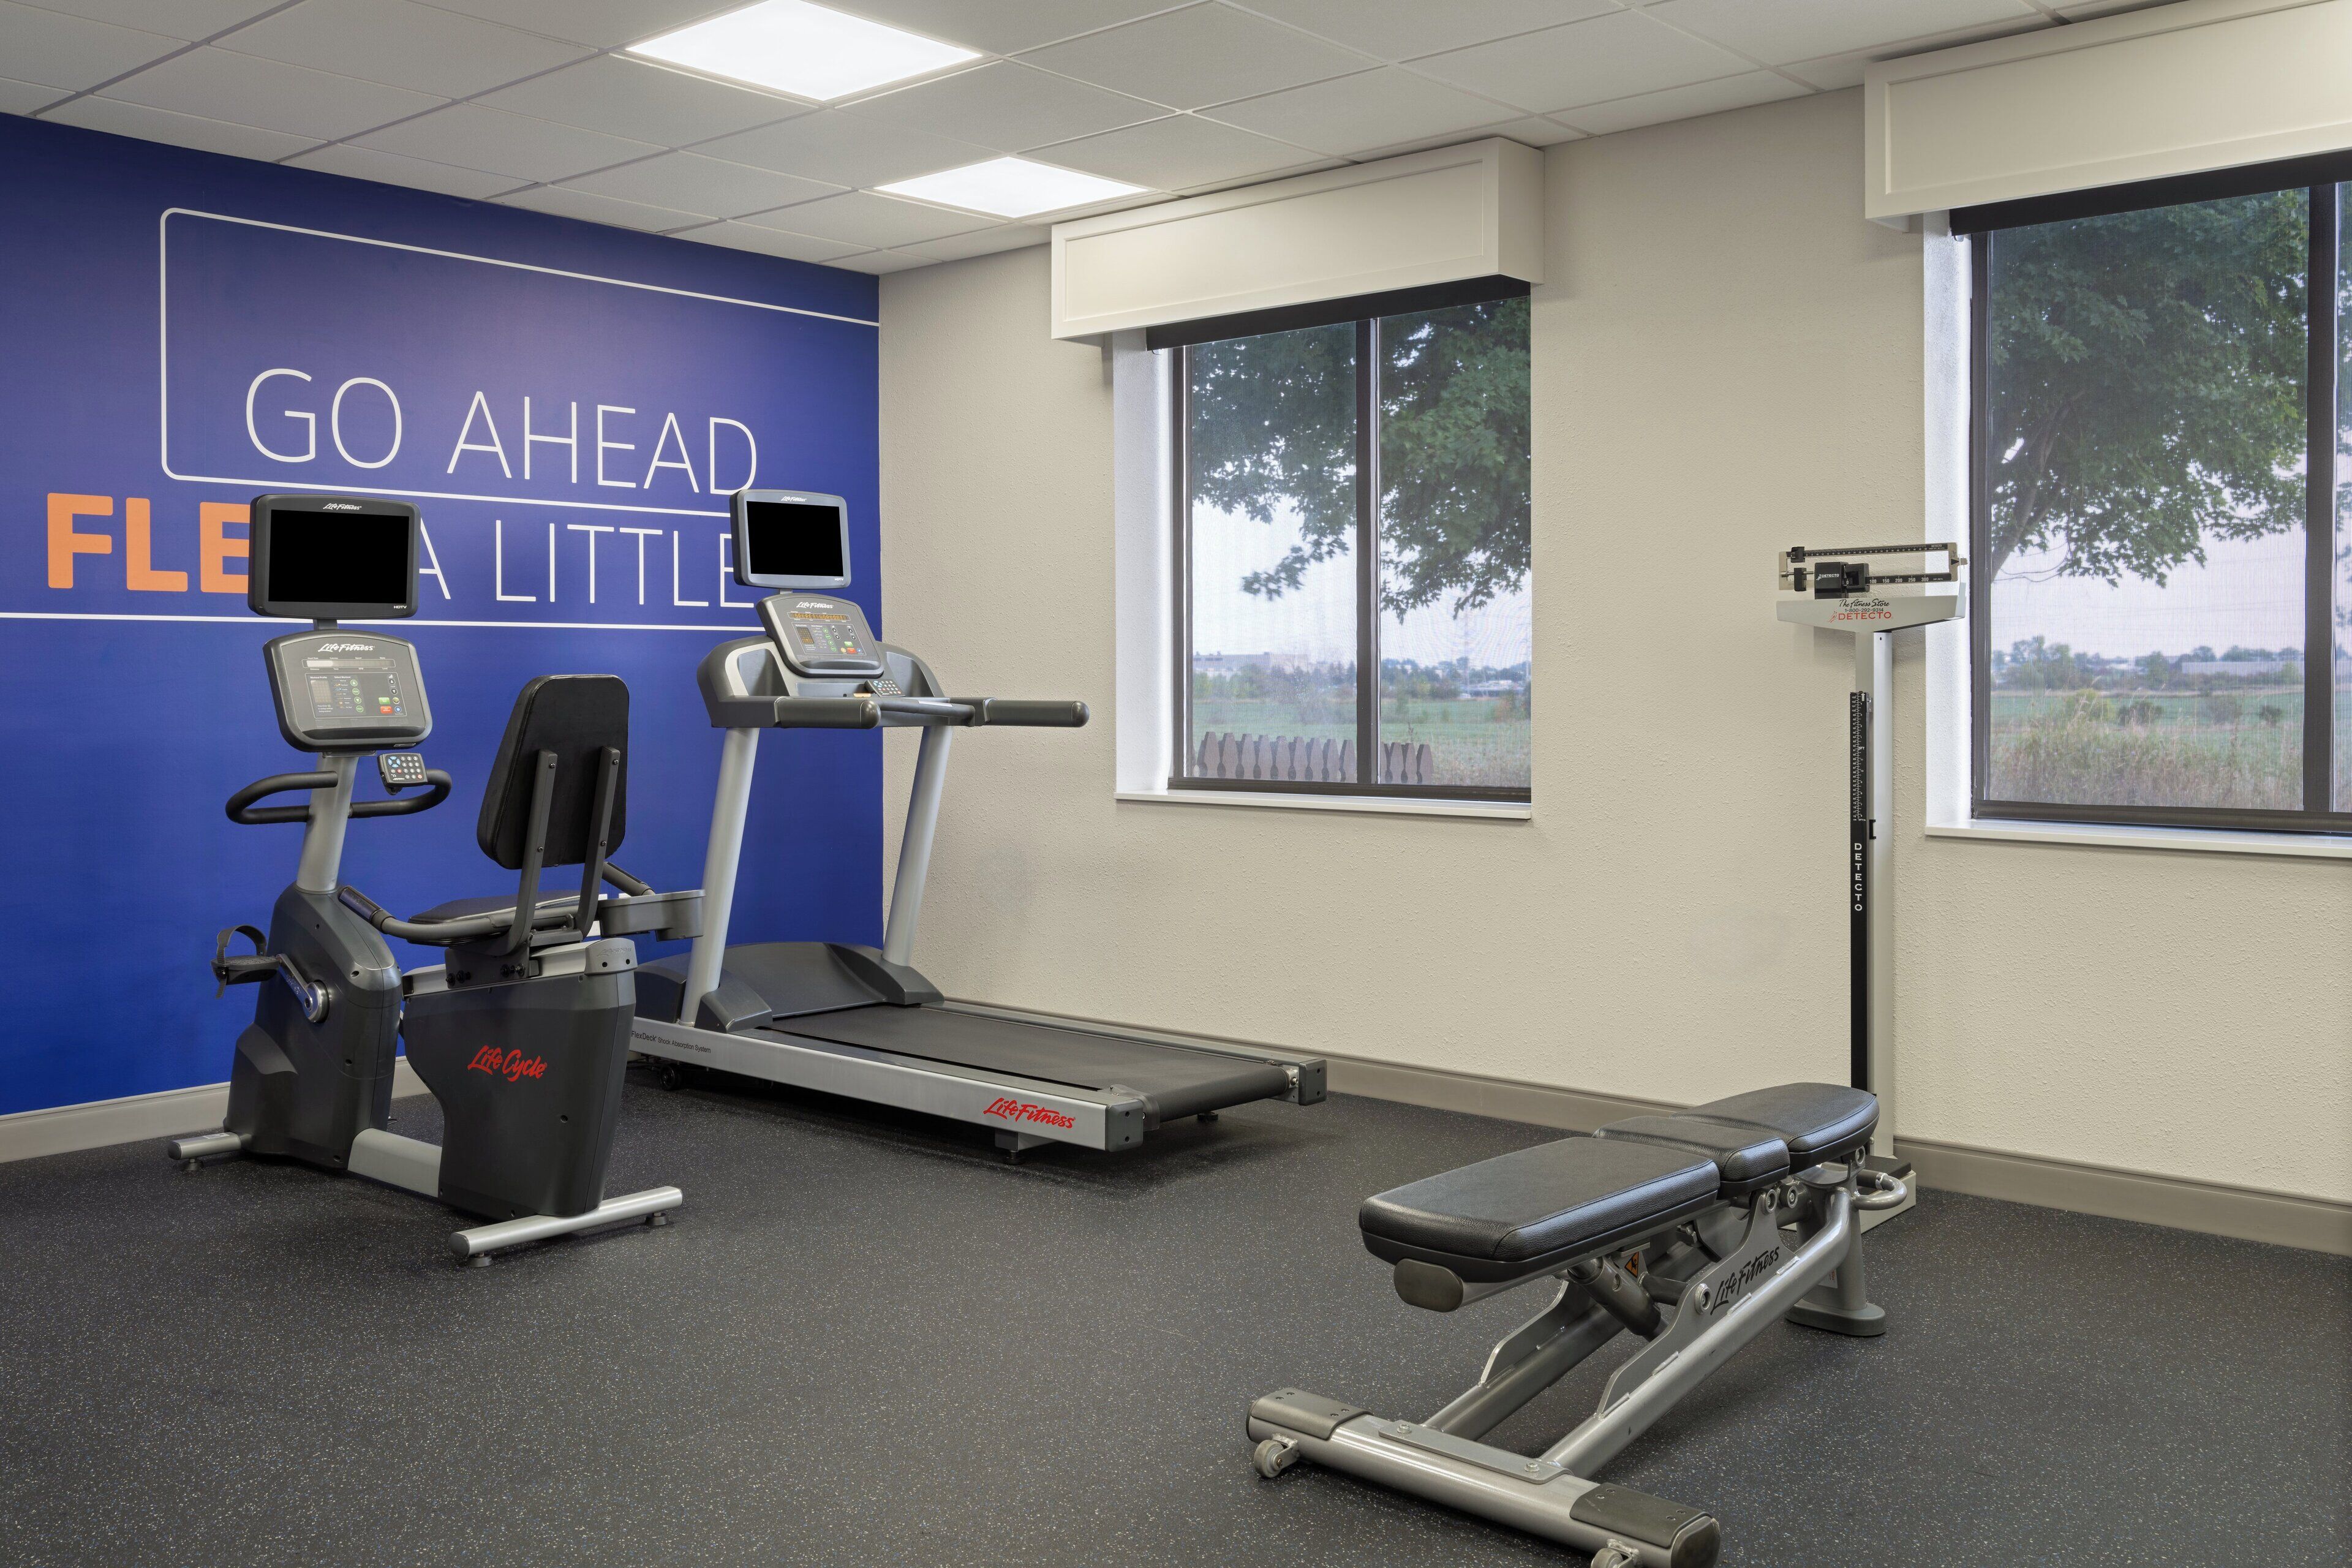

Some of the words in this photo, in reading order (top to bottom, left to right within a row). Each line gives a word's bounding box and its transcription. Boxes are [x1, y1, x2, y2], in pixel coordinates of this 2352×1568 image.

[246, 368, 402, 469] GO
[447, 391, 757, 496] AHEAD
[47, 493, 251, 593] FLE
[496, 519, 755, 608] LITTLE
[1838, 611, 1892, 620] DETECTO
[1839, 599, 1850, 608] The
[1871, 598, 1890, 608] Store
[1854, 843, 1863, 911] DETECTO
[658, 1036, 671, 1045] Shock
[671, 1039, 695, 1050] Absorption
[695, 1044, 711, 1054] System
